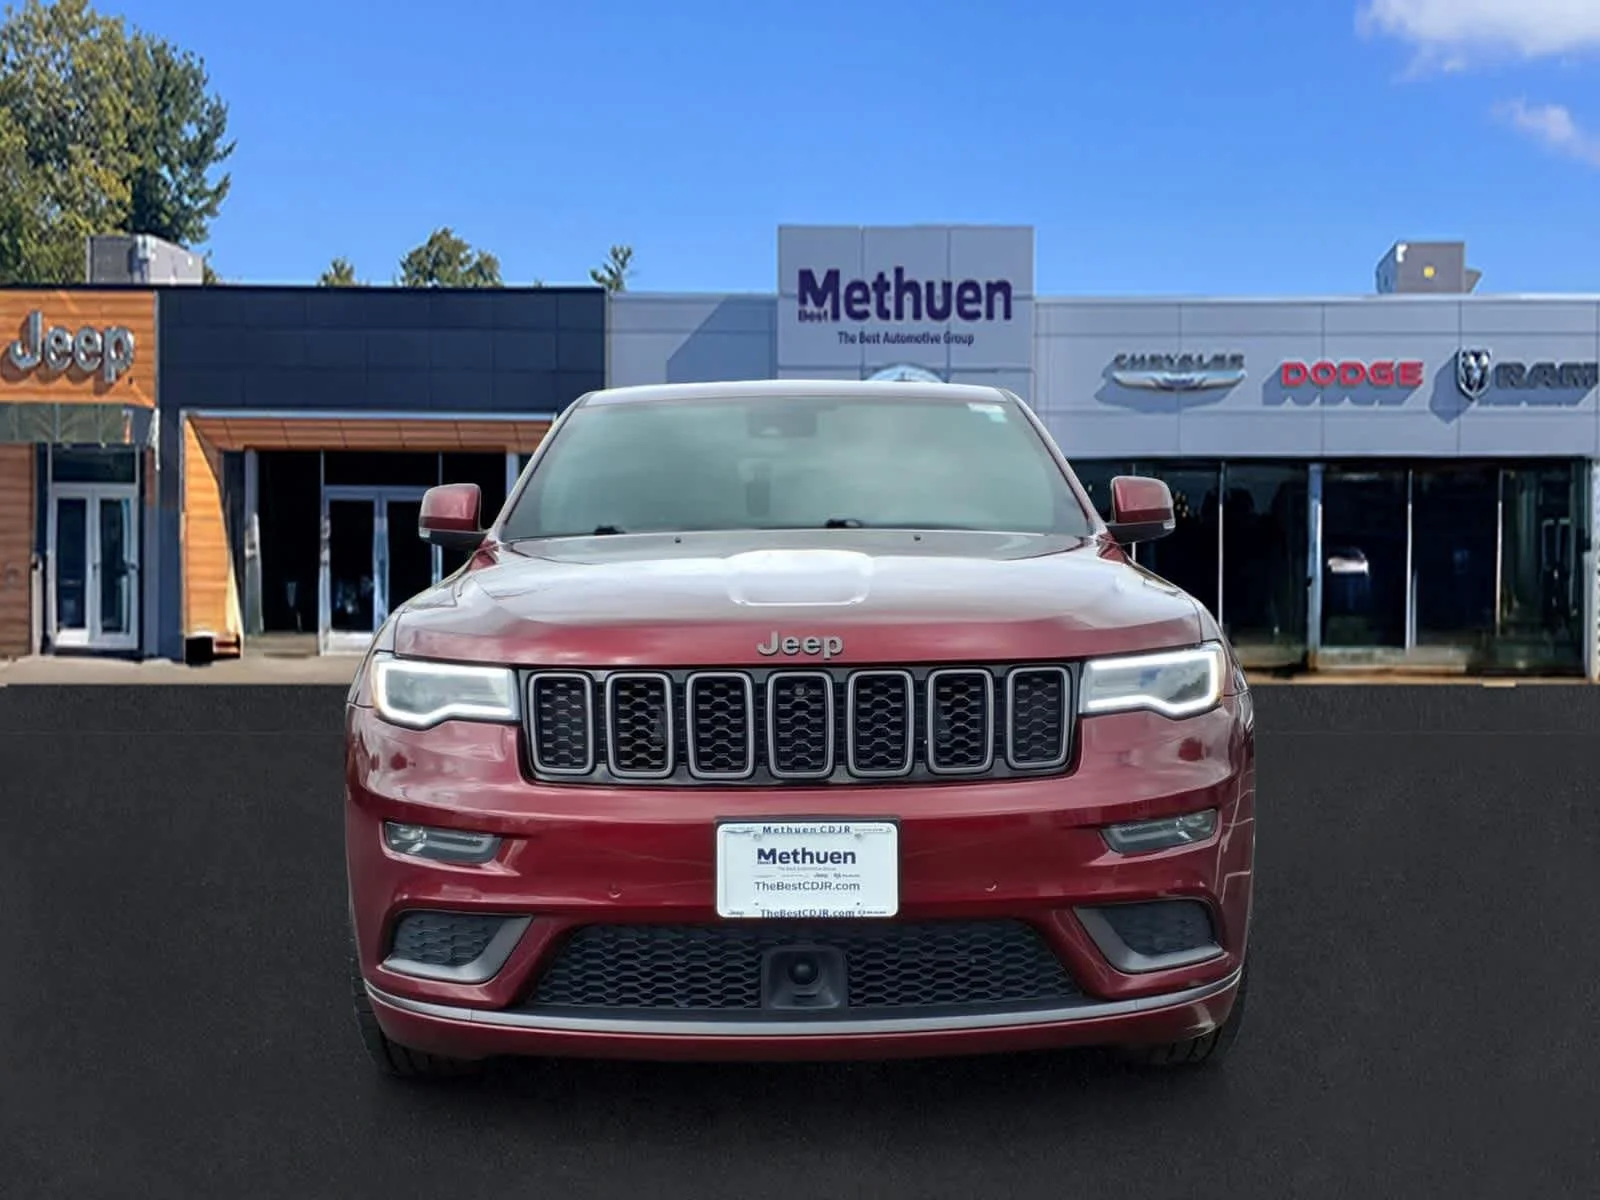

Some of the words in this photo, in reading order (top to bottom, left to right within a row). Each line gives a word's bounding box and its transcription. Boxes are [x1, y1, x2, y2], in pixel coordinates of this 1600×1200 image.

[798, 266, 1012, 322] Methuen
[9, 310, 135, 384] Jeep
[838, 331, 857, 344] The
[859, 331, 880, 344] Best
[883, 331, 941, 344] Automotive
[943, 331, 974, 346] Group
[1114, 353, 1244, 369] CHRYSLER
[1281, 361, 1424, 387] DODGE
[1494, 362, 1598, 387] RAM
[757, 631, 843, 660] Jeep
[757, 847, 856, 864] Methuen
[755, 881, 860, 891] TheBestCDJR.com
[761, 908, 855, 919] TheBestCDJR.com
